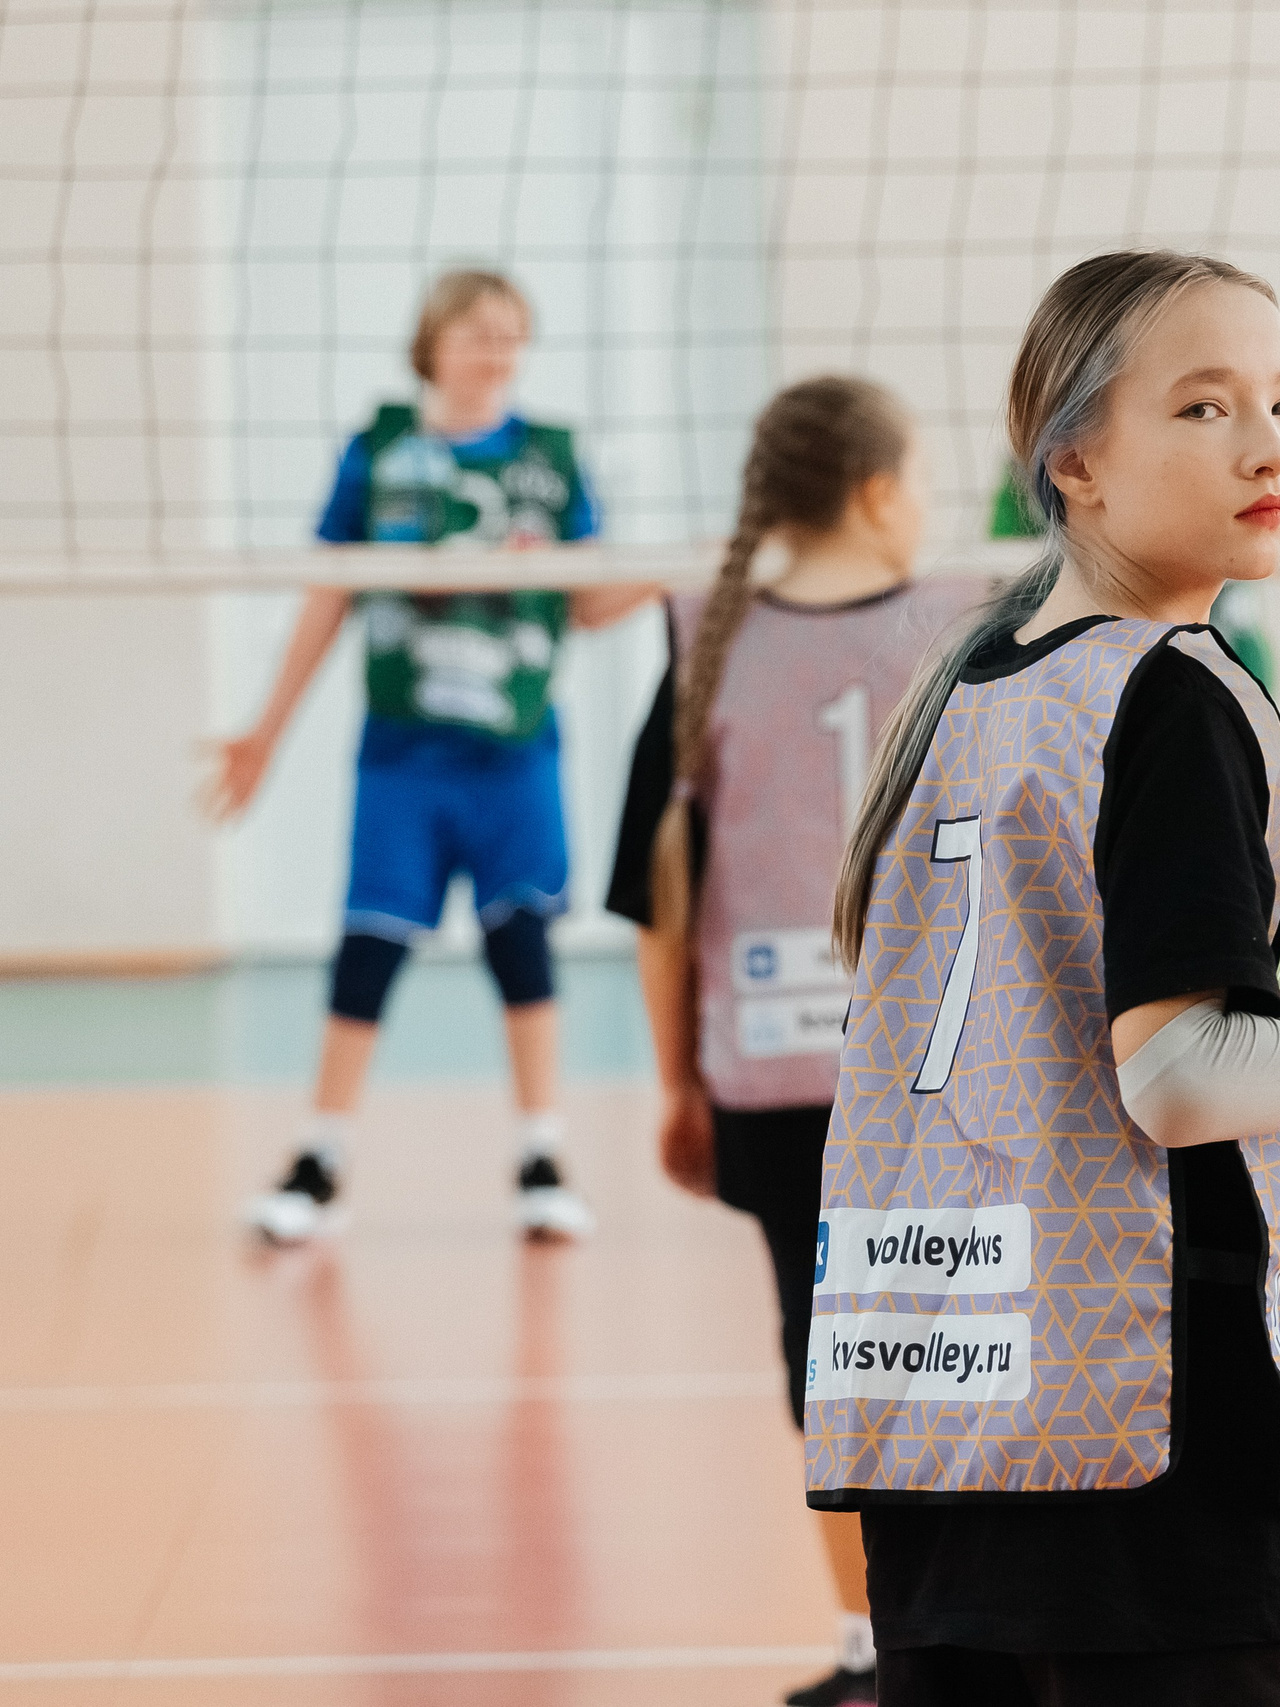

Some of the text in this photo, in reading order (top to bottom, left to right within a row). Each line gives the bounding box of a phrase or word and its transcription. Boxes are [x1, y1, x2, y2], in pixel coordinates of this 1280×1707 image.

[910, 810, 983, 1094] 7
[866, 1224, 1002, 1277] volleykvs
[831, 1330, 1012, 1383] kvsvolley.ru
